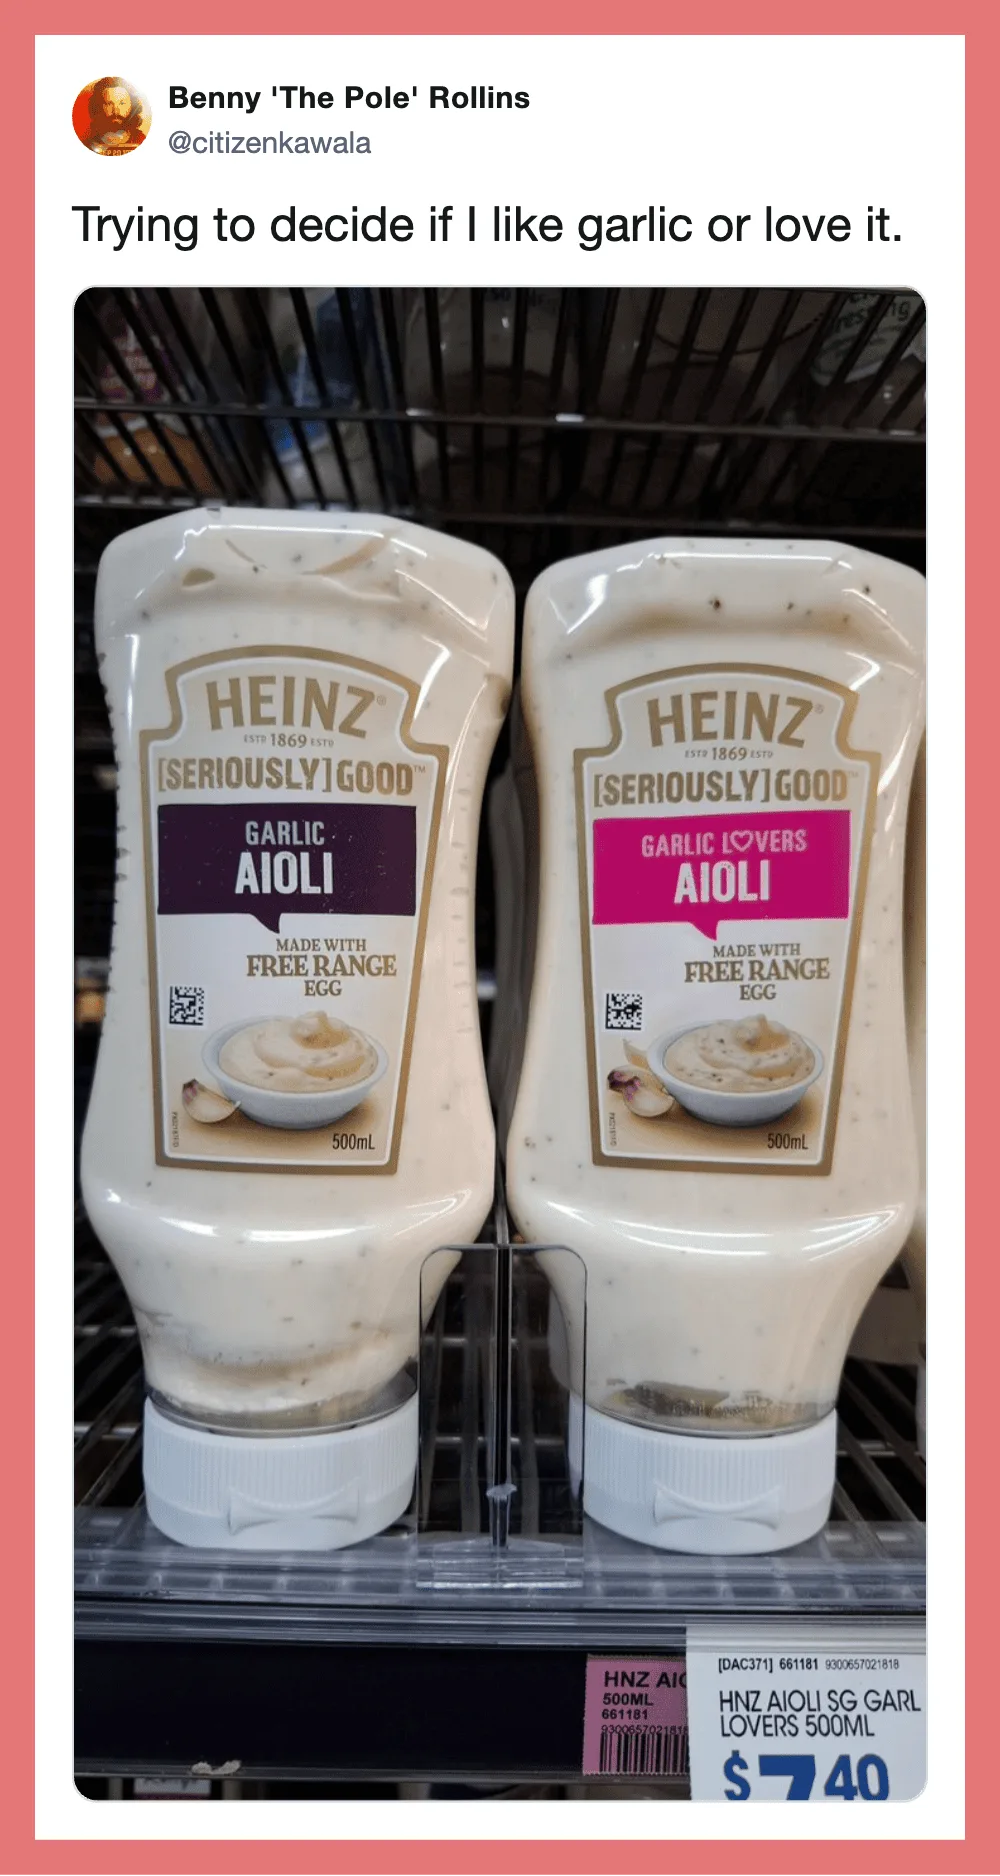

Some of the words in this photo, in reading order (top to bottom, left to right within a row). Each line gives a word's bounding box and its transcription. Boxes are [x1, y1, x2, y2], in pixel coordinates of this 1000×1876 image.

[269, 733, 307, 749] 1869
[711, 746, 748, 762] 1869
[245, 820, 325, 846] GARLIC
[641, 833, 715, 858] GARLIC
[234, 851, 333, 895] AIOLI
[674, 859, 770, 904] AIOLI
[276, 938, 321, 952] MADE
[324, 938, 367, 952] WITH
[712, 944, 756, 958] MADE
[759, 942, 801, 956] WITH
[246, 954, 310, 977] FREE
[313, 954, 397, 977] RANGE
[684, 961, 744, 983] FREE
[748, 957, 830, 981] RANGE
[303, 980, 343, 997] EGG
[739, 983, 777, 1000] EGG
[332, 1133, 375, 1151] 500mL
[767, 1133, 809, 1151] 500mL
[718, 1657, 773, 1674] [DAC371]
[779, 1657, 819, 1671] 661181
[825, 1658, 900, 1671] 9300657021818
[603, 1670, 650, 1688] HNZ
[602, 1692, 655, 1706] 500ML
[719, 1690, 762, 1713] HNZ
[767, 1690, 820, 1712] AIOLI
[827, 1689, 858, 1712] SG
[863, 1688, 922, 1712] GARL
[601, 1708, 649, 1720] 661181
[720, 1714, 800, 1737] LOVERS
[805, 1713, 875, 1737] 500ML
